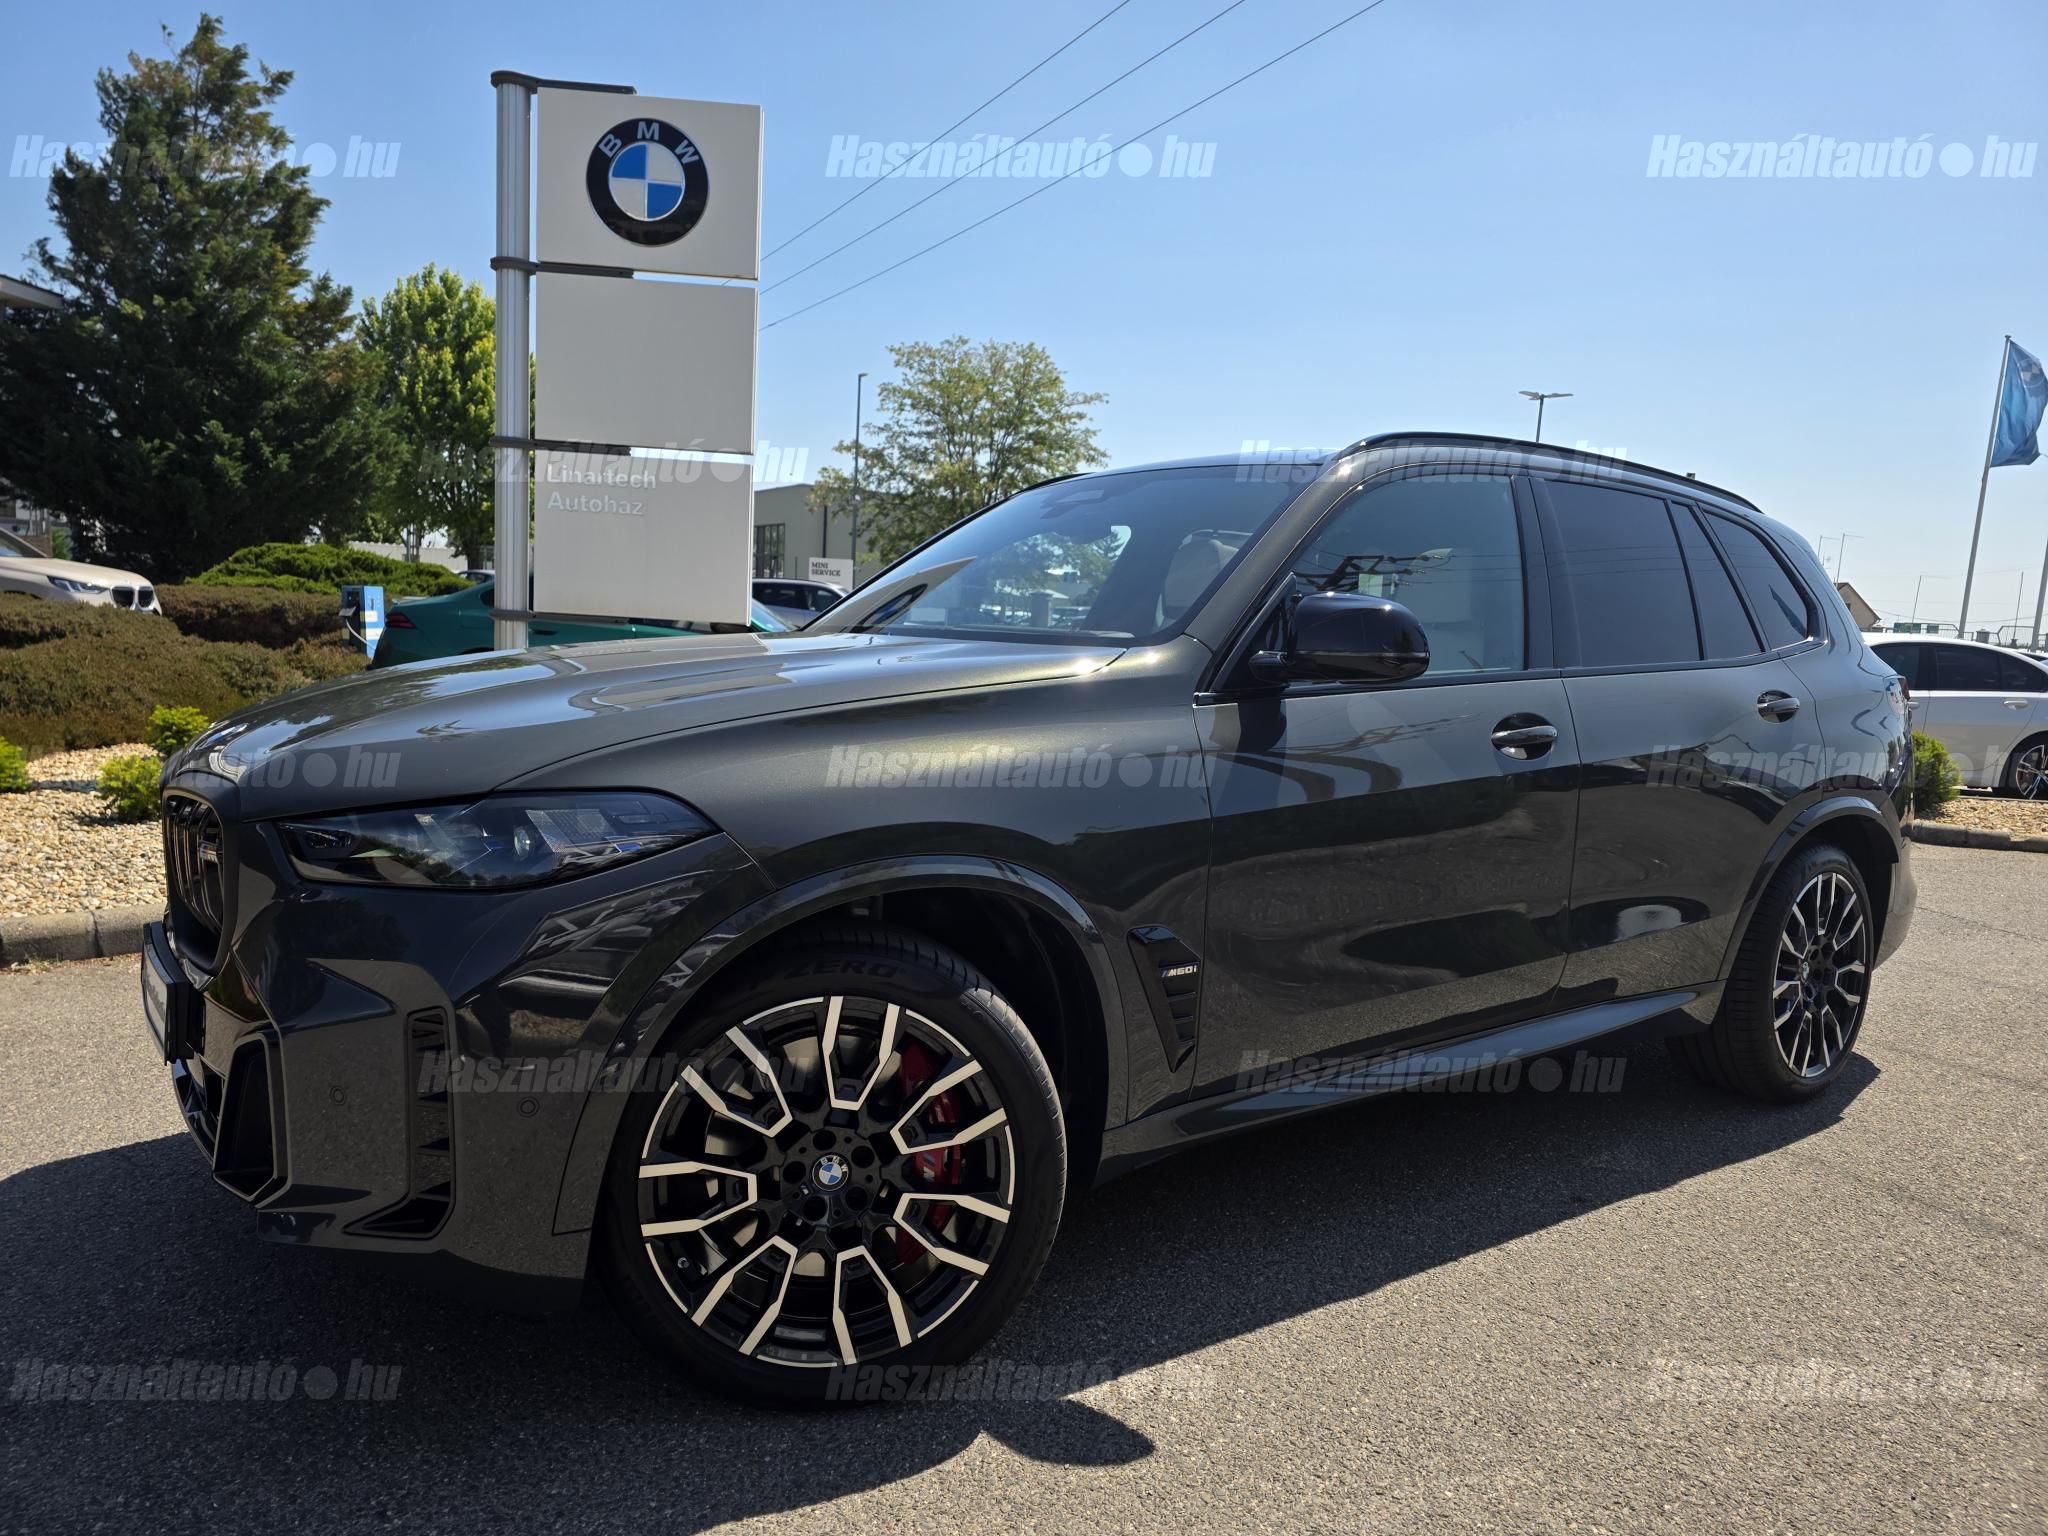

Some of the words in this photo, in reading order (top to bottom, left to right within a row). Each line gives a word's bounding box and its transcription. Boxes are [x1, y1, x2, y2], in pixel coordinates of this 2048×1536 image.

[598, 120, 699, 165] BMW
[546, 463, 657, 490] Linartech
[811, 569, 841, 577] SERVICE
